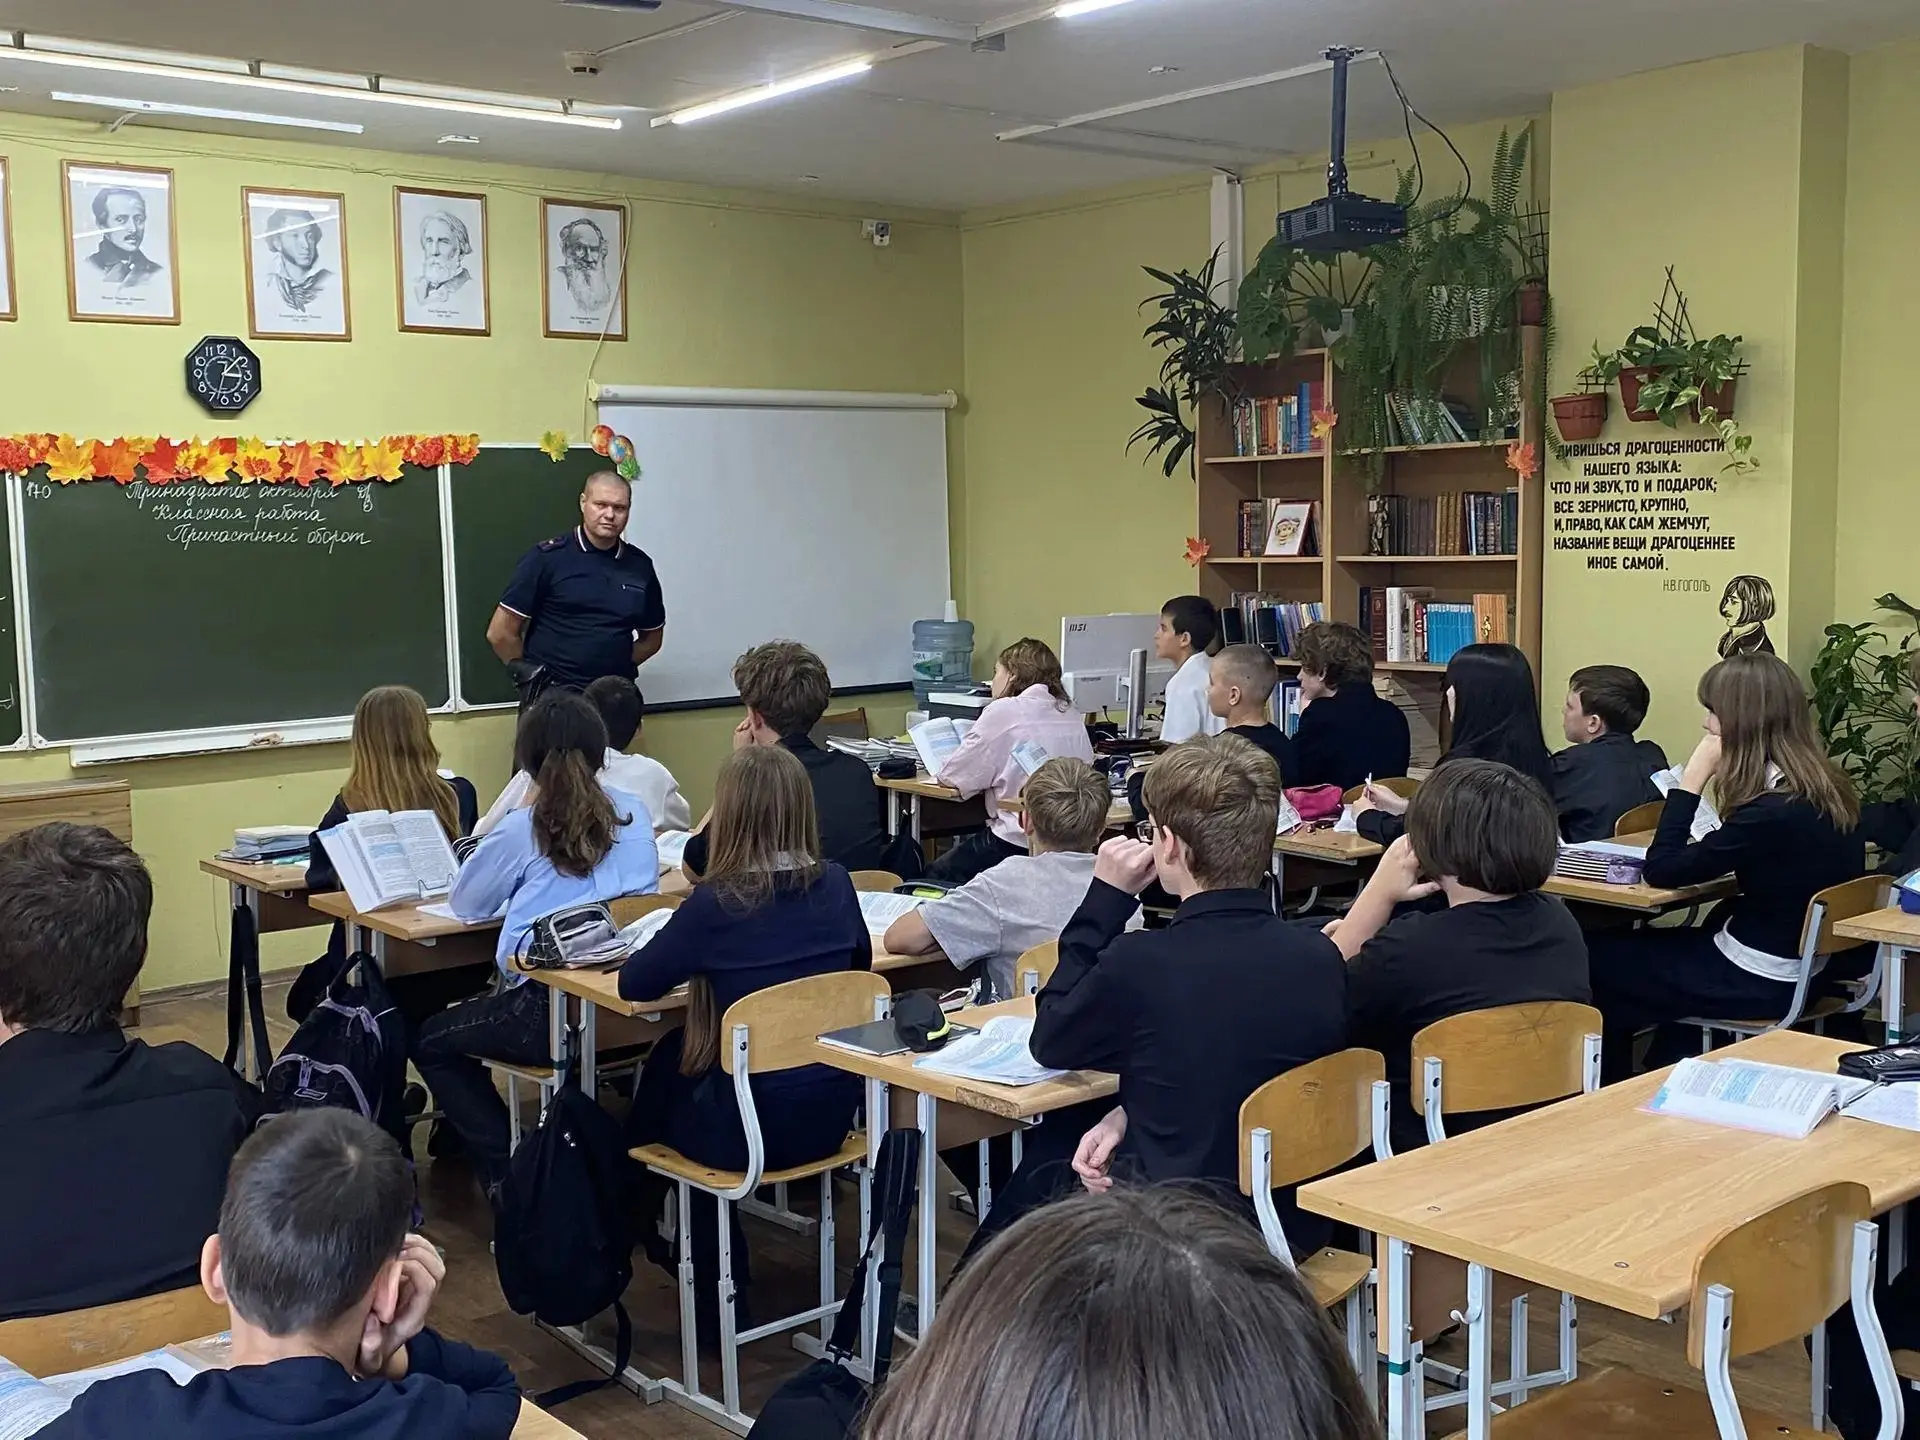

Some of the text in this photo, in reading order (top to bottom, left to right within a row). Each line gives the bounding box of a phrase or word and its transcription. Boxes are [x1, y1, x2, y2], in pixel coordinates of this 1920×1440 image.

[205, 346, 213, 357] 11
[216, 344, 227, 355] 12
[195, 355, 206, 367] 10
[240, 356, 248, 368] 2
[193, 368, 203, 380] 9
[243, 370, 252, 381] 3
[198, 381, 207, 393] 8
[240, 383, 248, 394] 4
[209, 391, 216, 402] 7
[220, 395, 229, 405] 6
[233, 392, 242, 403] 5
[1625, 438, 1724, 456] ДРАГОЦЕННОСТИ
[1584, 460, 1682, 476] НАШЕГО ЯЗЫКА:
[1550, 477, 1717, 495] ЧТО НИ ЗВУК, ТО И ПОДАРОК;
[126, 481, 250, 509] Тринадцатое
[1554, 498, 1689, 515] ВСЕ ЗЕРНИСТО, КРУПНО,
[152, 503, 327, 530] Классная работа
[1554, 516, 1710, 533] И, ПРАВО, КАК САМ ЖЕМЧУГ,
[167, 523, 371, 554] Причастный оборот
[1553, 536, 1735, 551] НАЗВАНИЕ ВЕЩИ ДРАГОЦЕННЕЕ
[1587, 553, 1669, 570] ИНОЕ САМОЙ.
